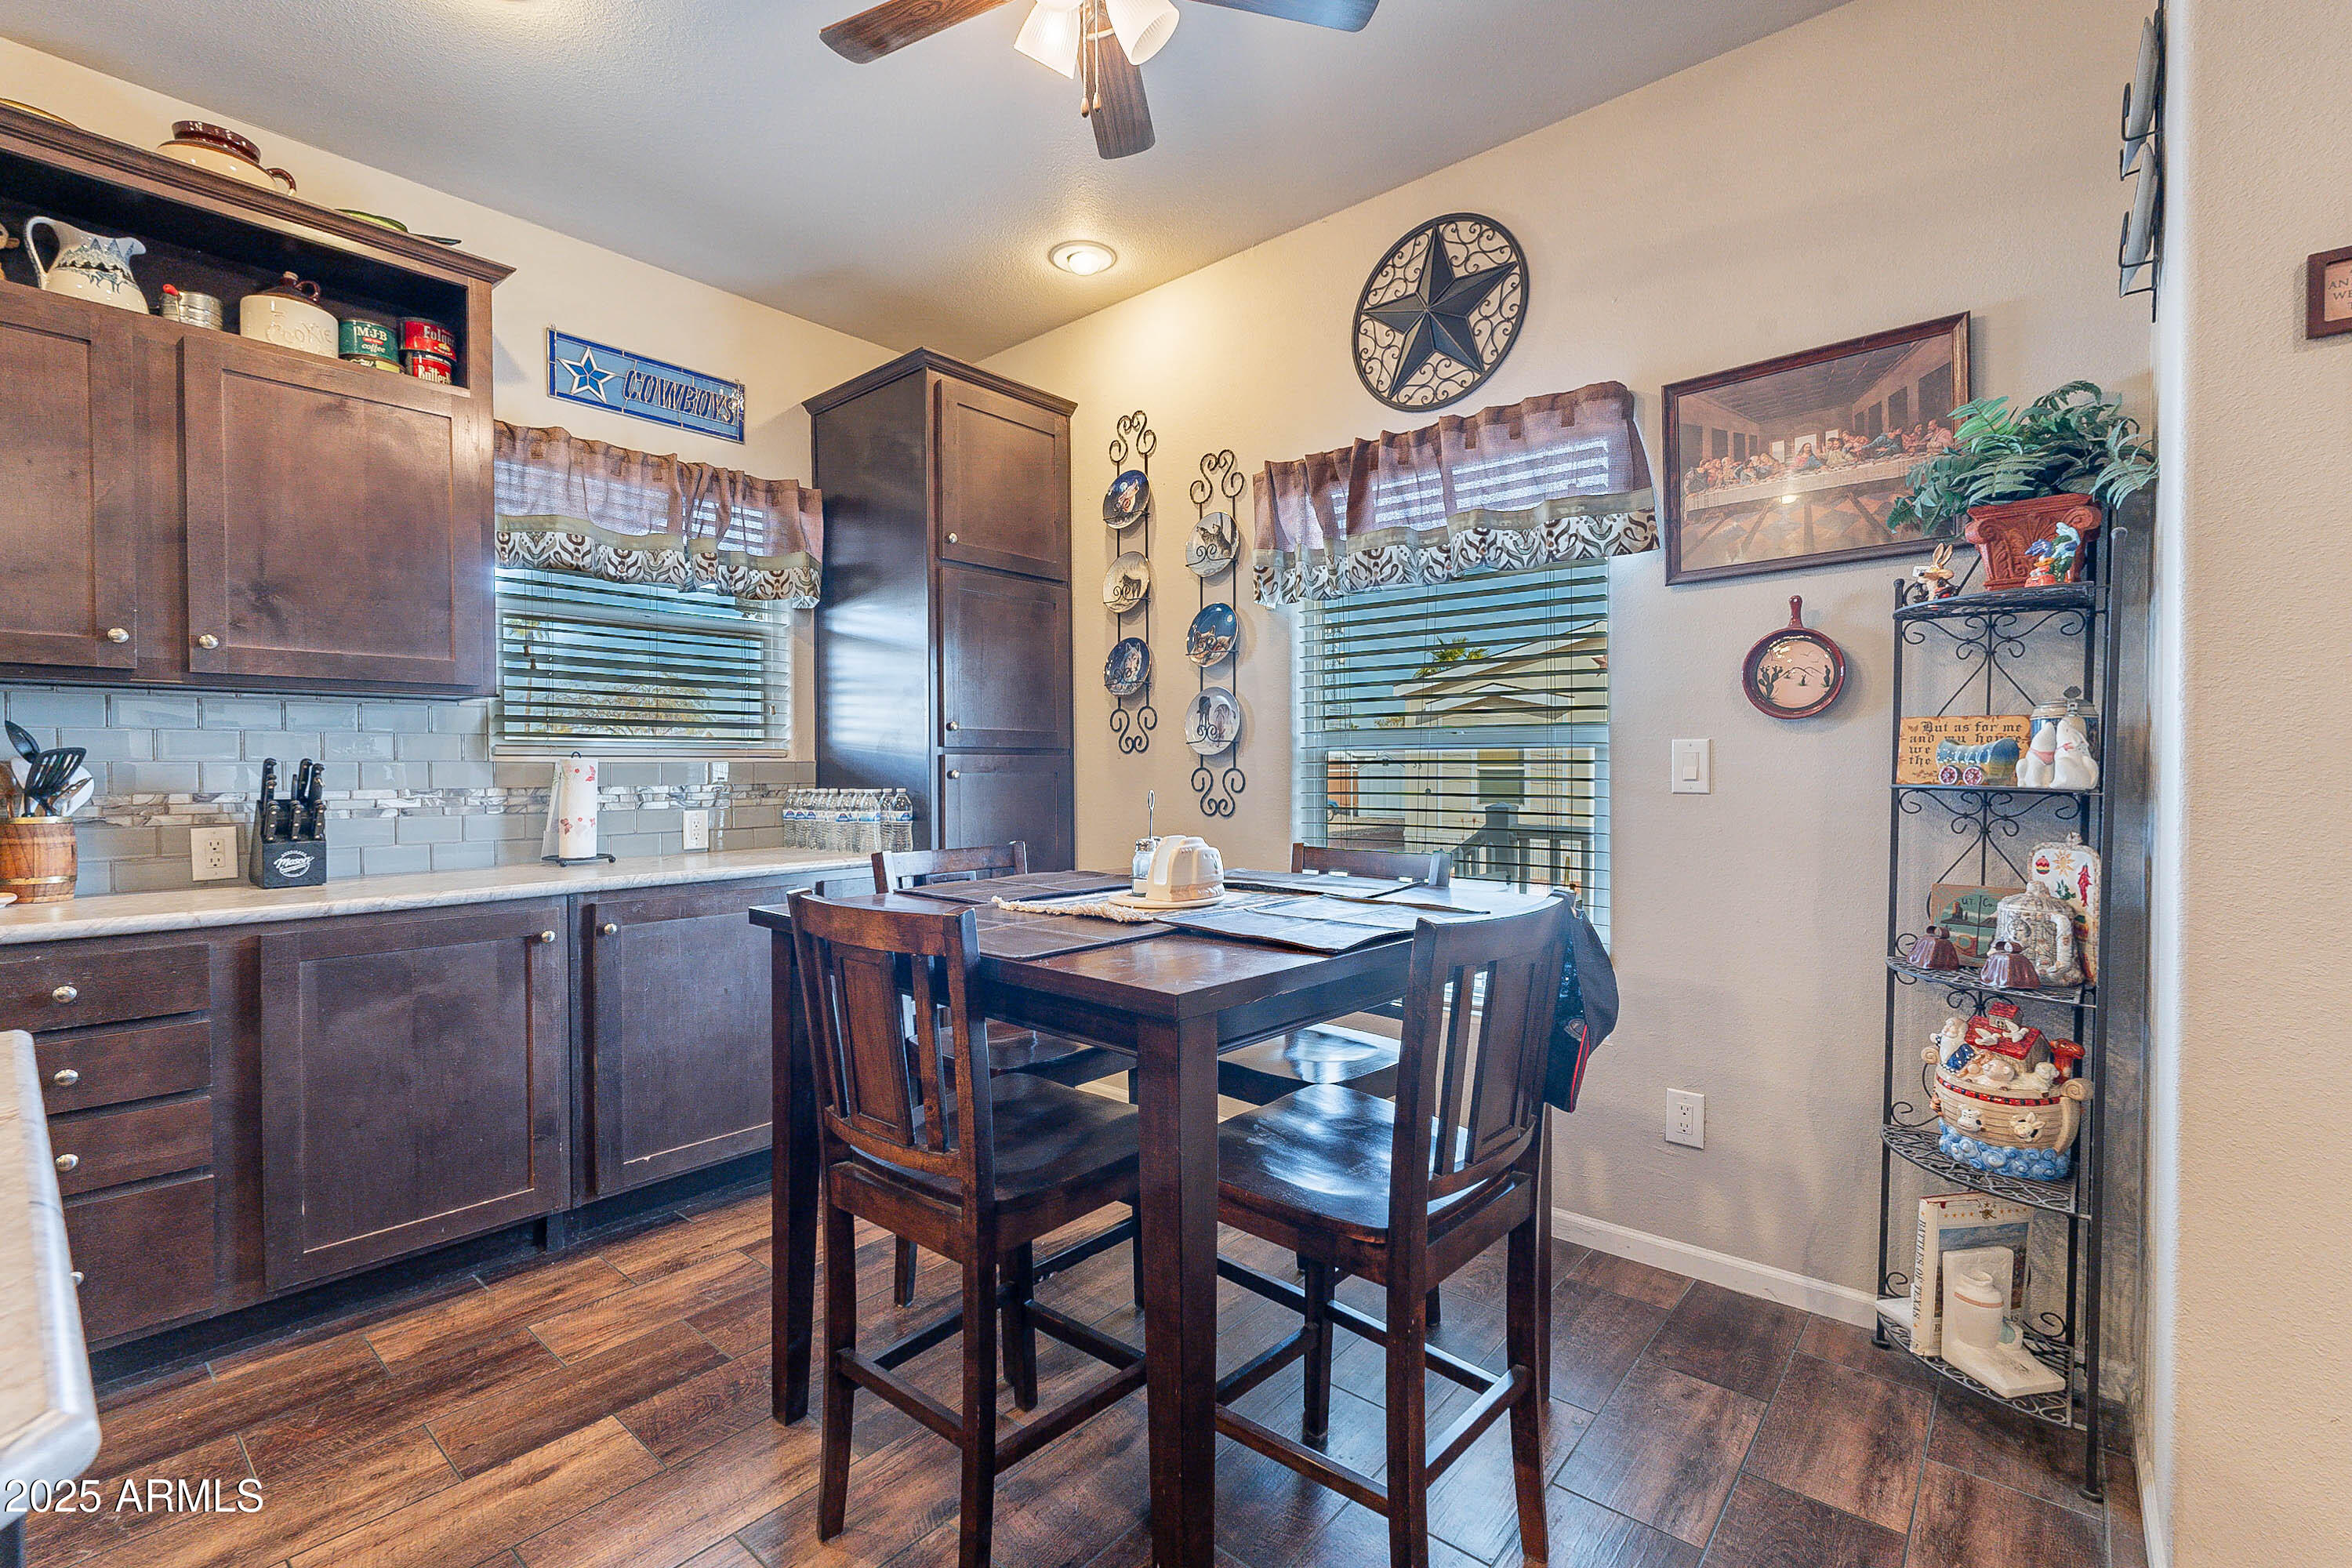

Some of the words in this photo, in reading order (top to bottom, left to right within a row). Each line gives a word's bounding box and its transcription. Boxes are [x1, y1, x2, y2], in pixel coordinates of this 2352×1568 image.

[623, 369, 735, 425] COWBOYS
[1920, 720, 1947, 733] But
[1975, 721, 1997, 732] for
[1909, 734, 1935, 743] and
[1909, 746, 1931, 754] we
[1909, 755, 1931, 767] the
[1915, 1219, 1926, 1266] BATTLES
[1915, 1268, 1925, 1282] OF
[1912, 1284, 1922, 1320] TEXAS
